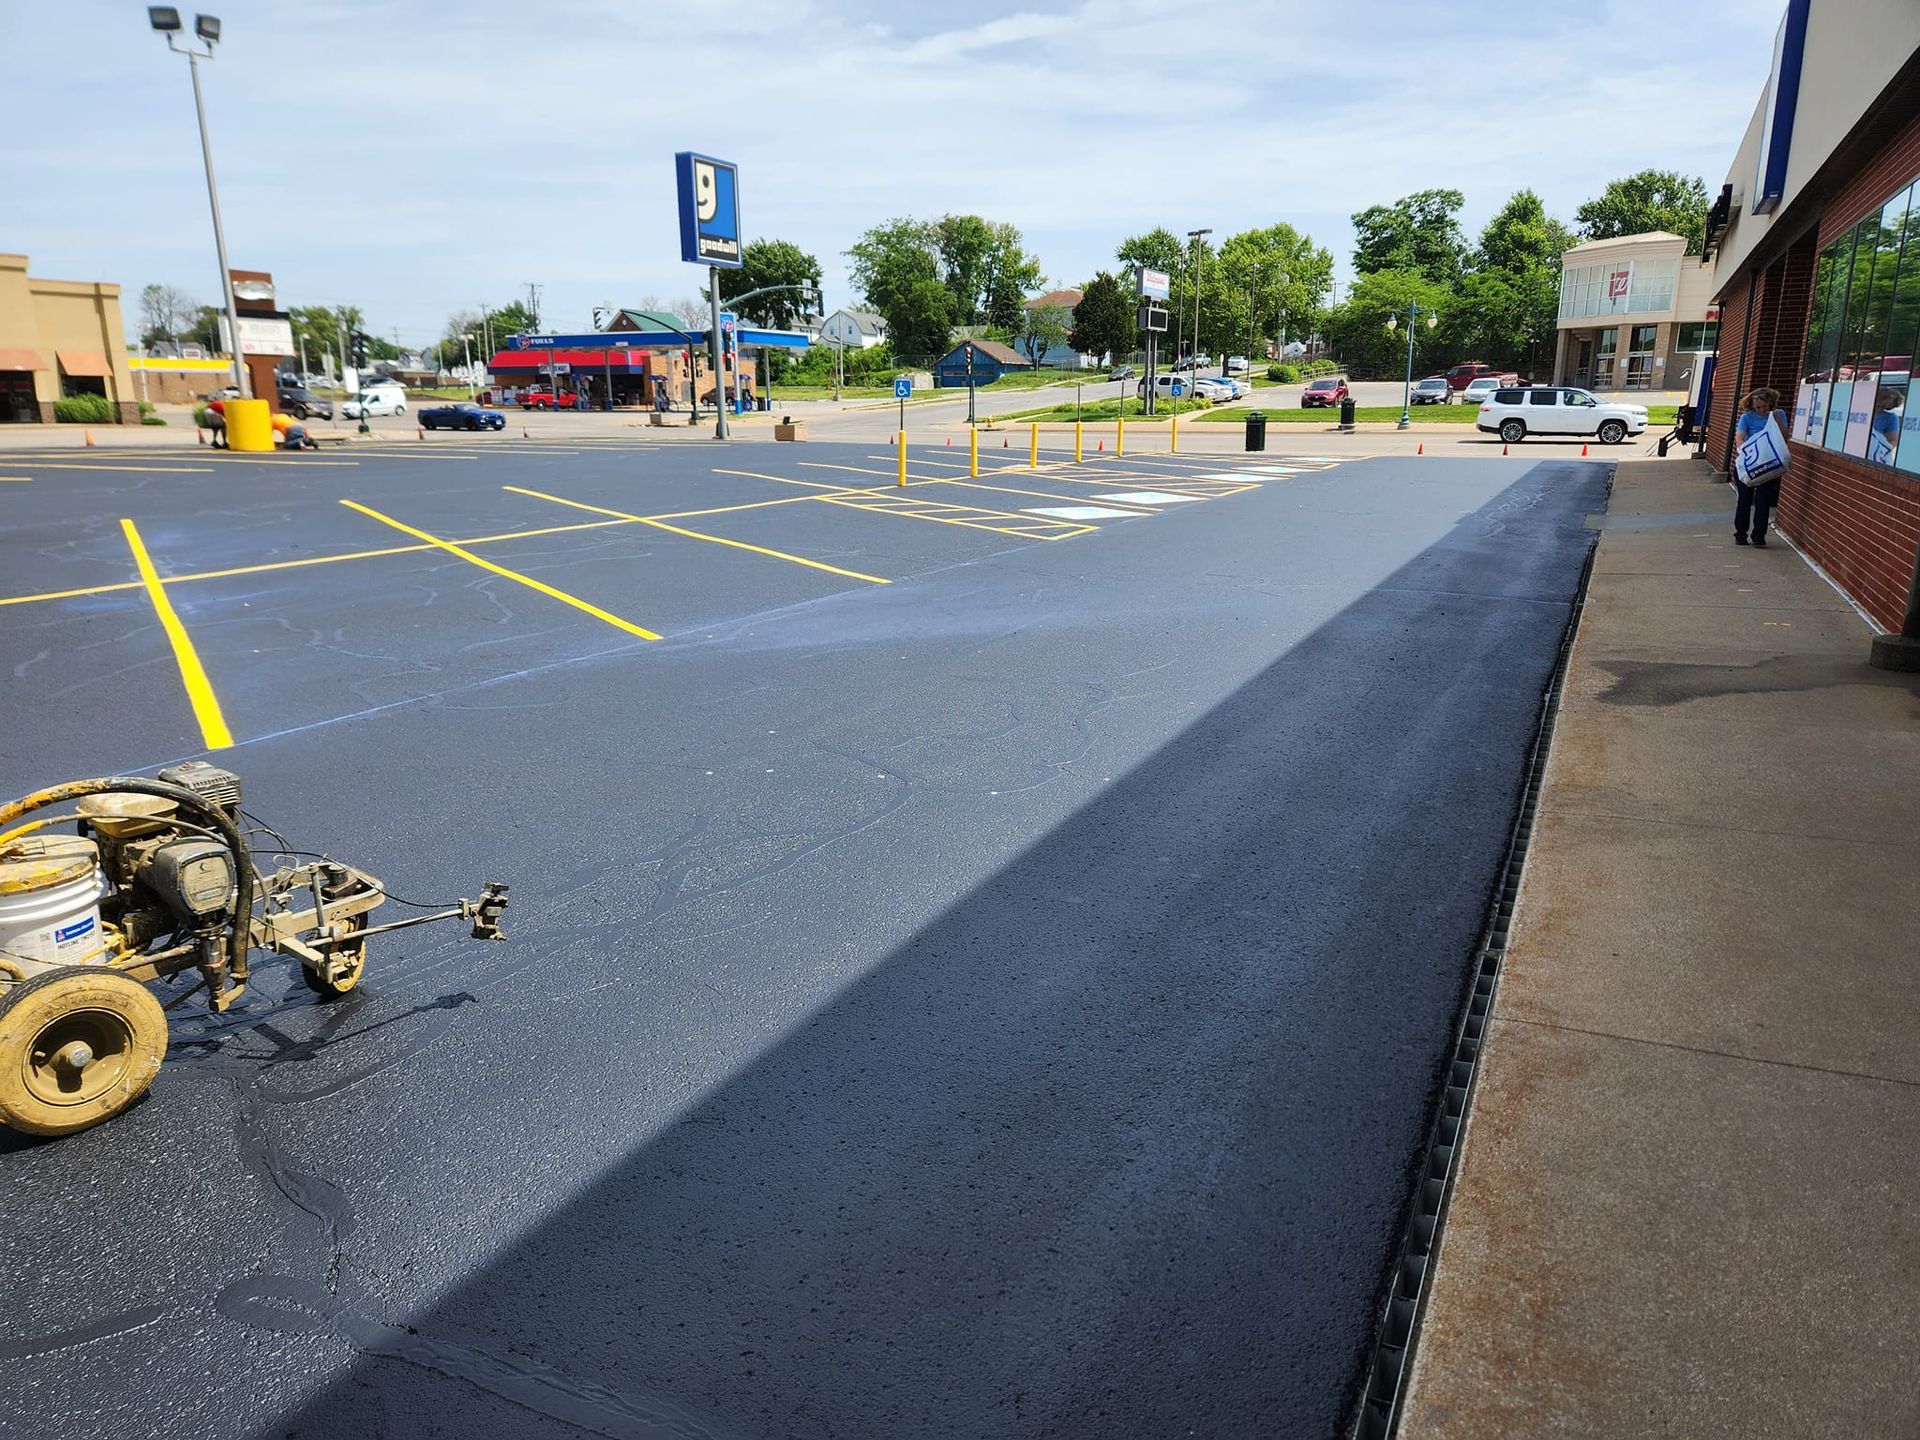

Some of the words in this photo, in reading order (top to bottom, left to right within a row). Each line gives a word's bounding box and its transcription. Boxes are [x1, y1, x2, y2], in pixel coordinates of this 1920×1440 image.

[700, 238, 737, 255] goodwill
[531, 337, 554, 345] FUELS
[1749, 459, 1780, 478] goodwill
[57, 939, 79, 950] HOTLINE
